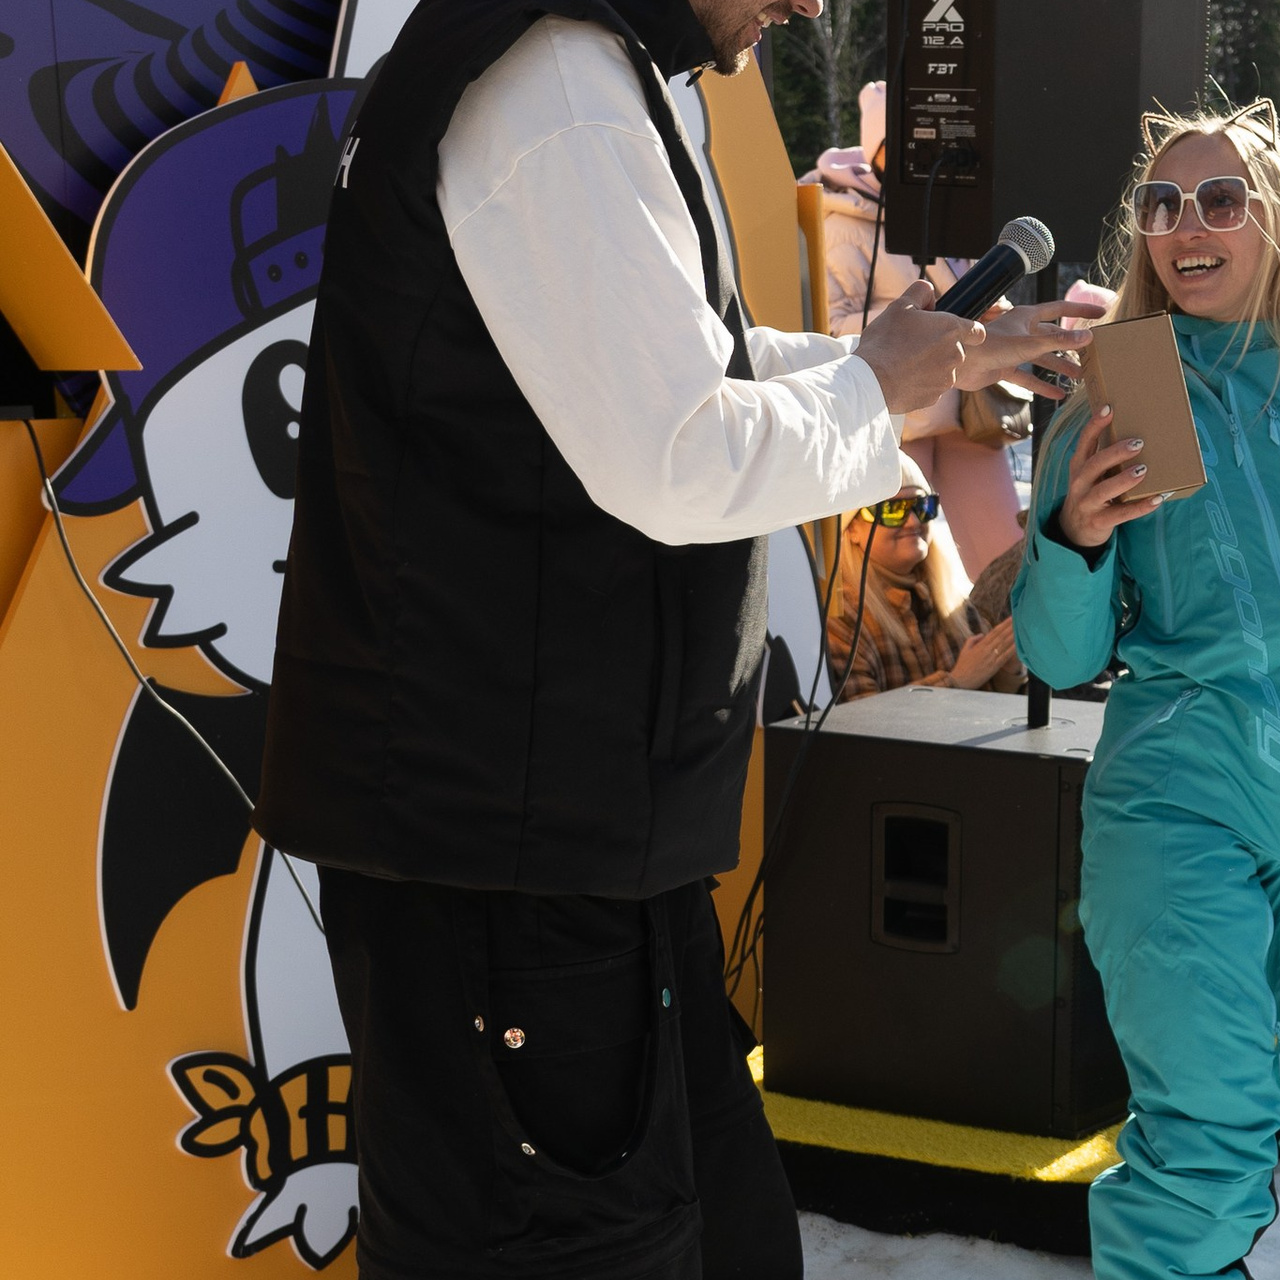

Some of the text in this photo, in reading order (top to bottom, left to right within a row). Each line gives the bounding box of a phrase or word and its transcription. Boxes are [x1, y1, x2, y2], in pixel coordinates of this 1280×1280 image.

[921, 22, 965, 33] PRO
[921, 35, 965, 46] 112 A
[927, 63, 958, 75] FBT
